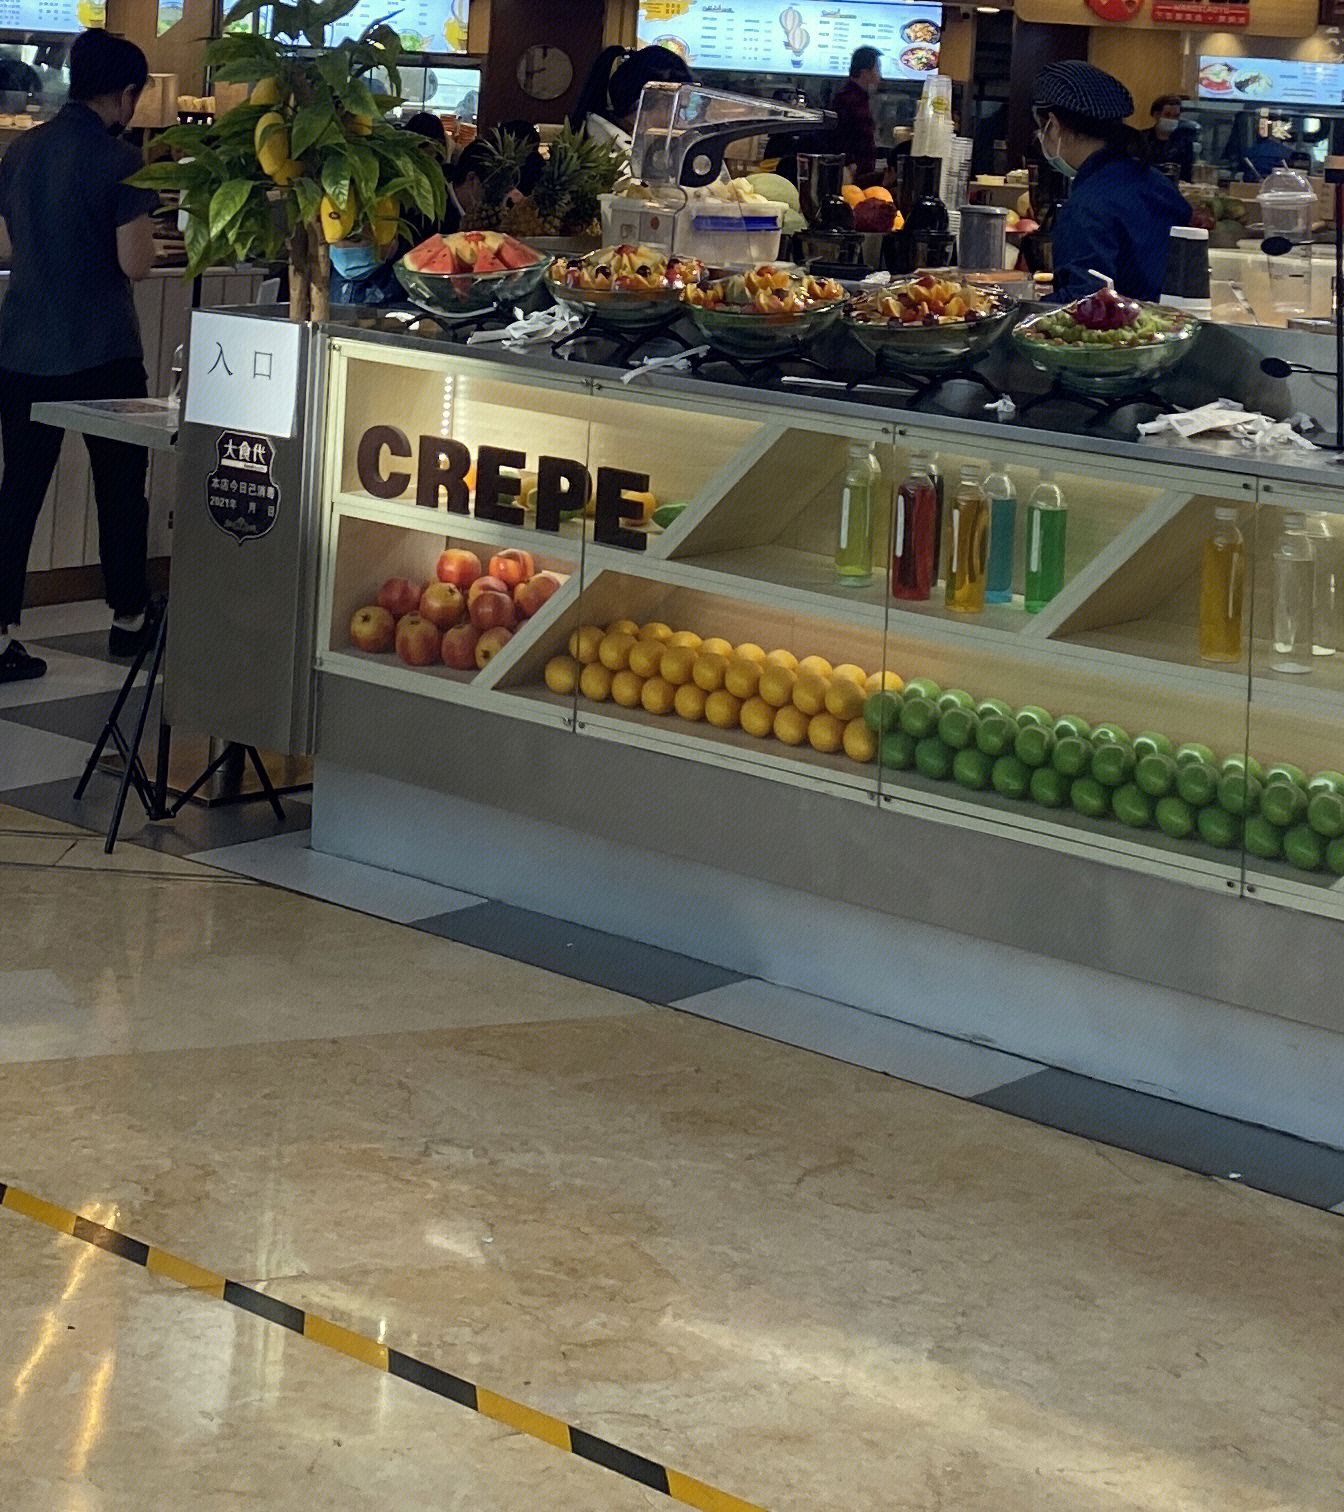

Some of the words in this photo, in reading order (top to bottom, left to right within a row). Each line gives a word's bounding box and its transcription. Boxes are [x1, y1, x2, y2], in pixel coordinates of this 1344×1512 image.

[207, 341, 273, 381] 入口
[223, 439, 267, 465] 大食代
[356, 424, 652, 551] CREPE
